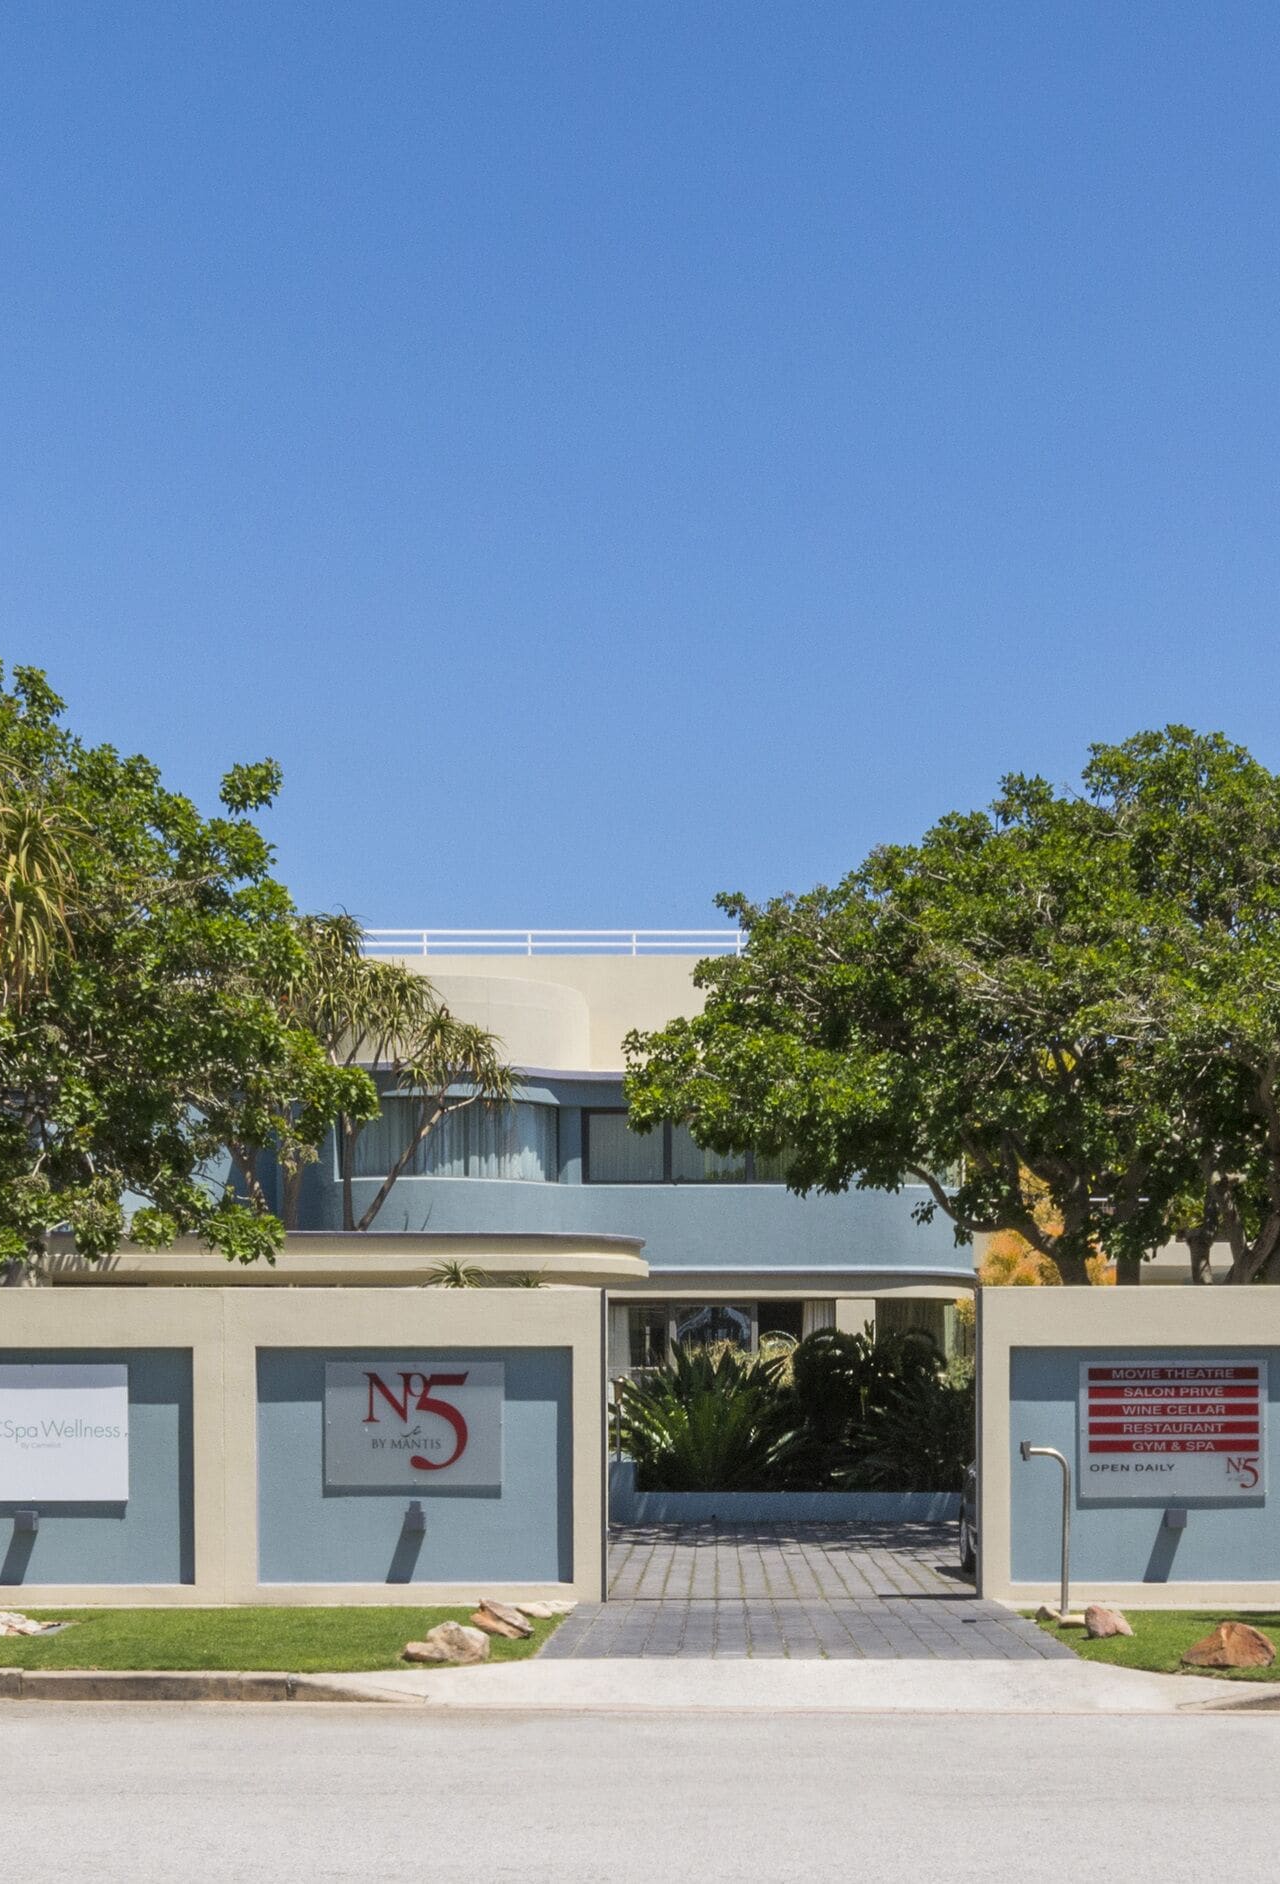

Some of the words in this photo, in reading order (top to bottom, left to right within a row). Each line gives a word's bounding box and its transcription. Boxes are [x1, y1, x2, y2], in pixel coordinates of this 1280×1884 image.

[1112, 1368, 1161, 1379] MOVIE
[1165, 1367, 1235, 1379] THEATRE
[1123, 1386, 1175, 1397] SALON
[1122, 1405, 1162, 1415] WINE
[1166, 1404, 1226, 1415] CELLAR
[40, 1418, 120, 1438] Wellness
[1123, 1423, 1224, 1434] RESTAURANT
[371, 1438, 387, 1449] BY
[391, 1438, 442, 1450] MANTIS
[1132, 1441, 1166, 1452] GYM
[1170, 1441, 1183, 1452] &
[1185, 1441, 1216, 1451] SPA
[1089, 1463, 1131, 1473] OPEN
[1134, 1463, 1176, 1472] DAILY
